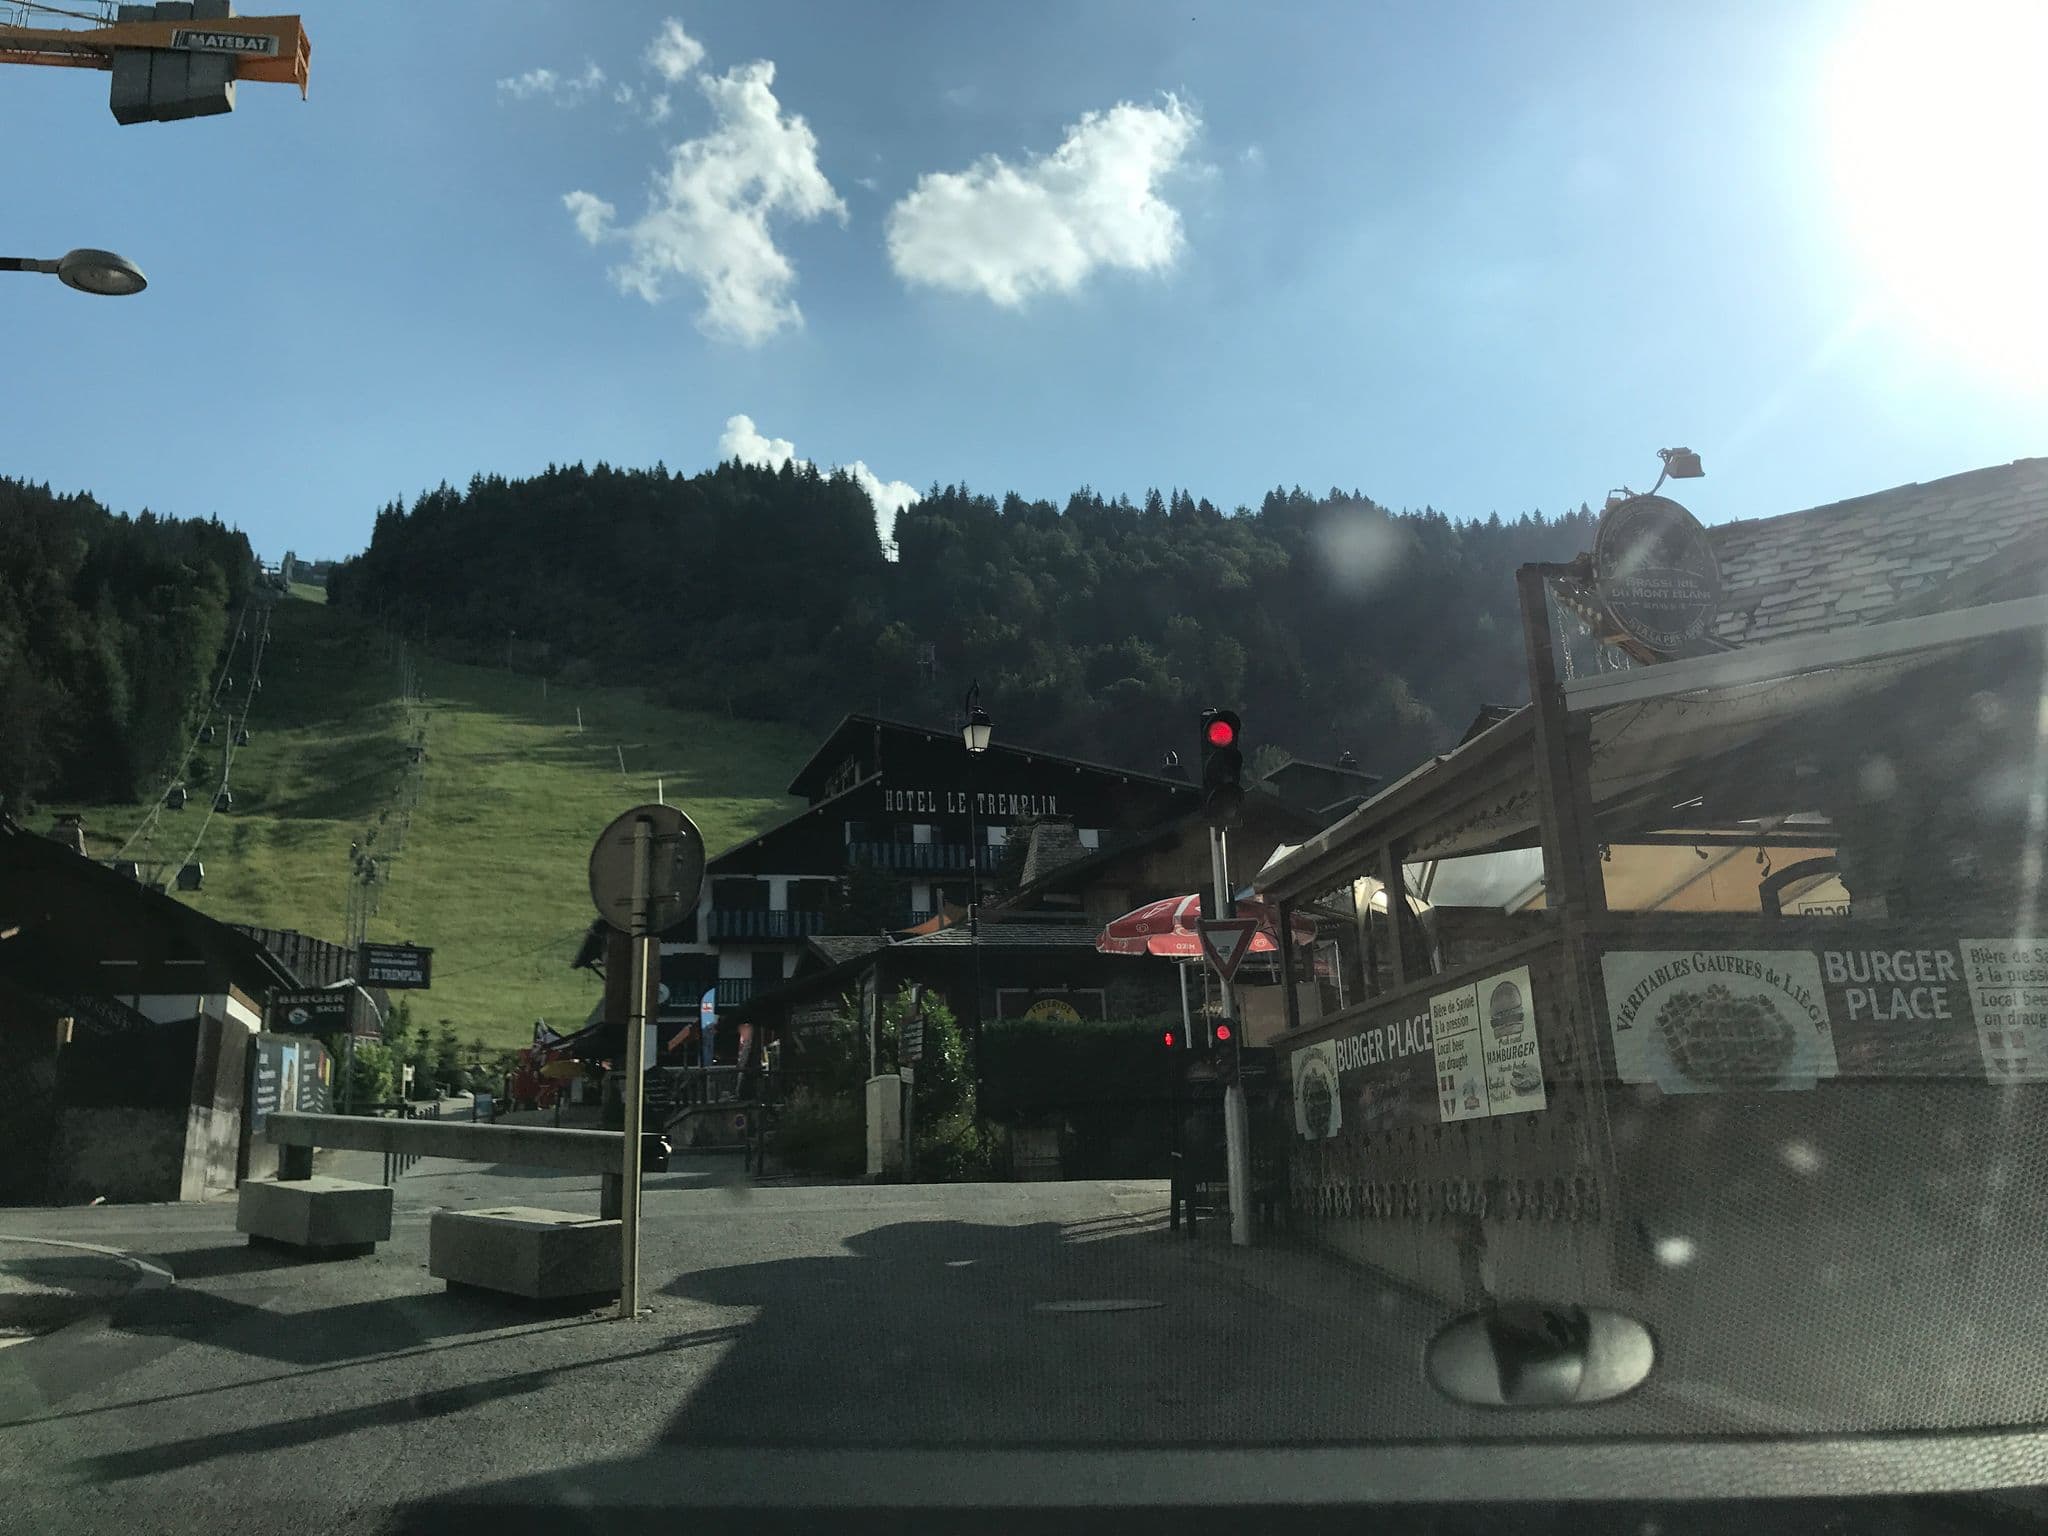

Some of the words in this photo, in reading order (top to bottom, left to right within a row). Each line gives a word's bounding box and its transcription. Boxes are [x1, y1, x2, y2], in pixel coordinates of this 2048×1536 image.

[885, 789, 936, 812] HOTEL
[947, 791, 966, 814] LE
[977, 793, 1056, 816] TREMPLIN
[1823, 950, 1959, 983] BURGER
[1970, 947, 2006, 964] Bière
[2012, 949, 2030, 963] de
[1975, 967, 1984, 982] à
[1987, 966, 2002, 982] la
[1616, 957, 1691, 1033] VÉRITABLES
[1692, 952, 1762, 979] GAUFRES
[1765, 967, 1780, 987] de
[1780, 973, 1829, 1034] LIÈGE
[1845, 986, 1952, 1021] PLACE
[1981, 991, 2017, 1007] Local
[1433, 1003, 1447, 1018] Bière
[1447, 999, 1456, 1014] de
[1456, 994, 1475, 1012] Savoie
[1446, 1013, 1469, 1034] pression
[1336, 1028, 1385, 1073] BURGER
[1386, 1013, 1433, 1060] PLACE
[1437, 1039, 1451, 1056] Local
[1451, 1038, 1465, 1053] beer
[1487, 1040, 1535, 1065] HAMBURGER
[1446, 1053, 1469, 1071] draught
